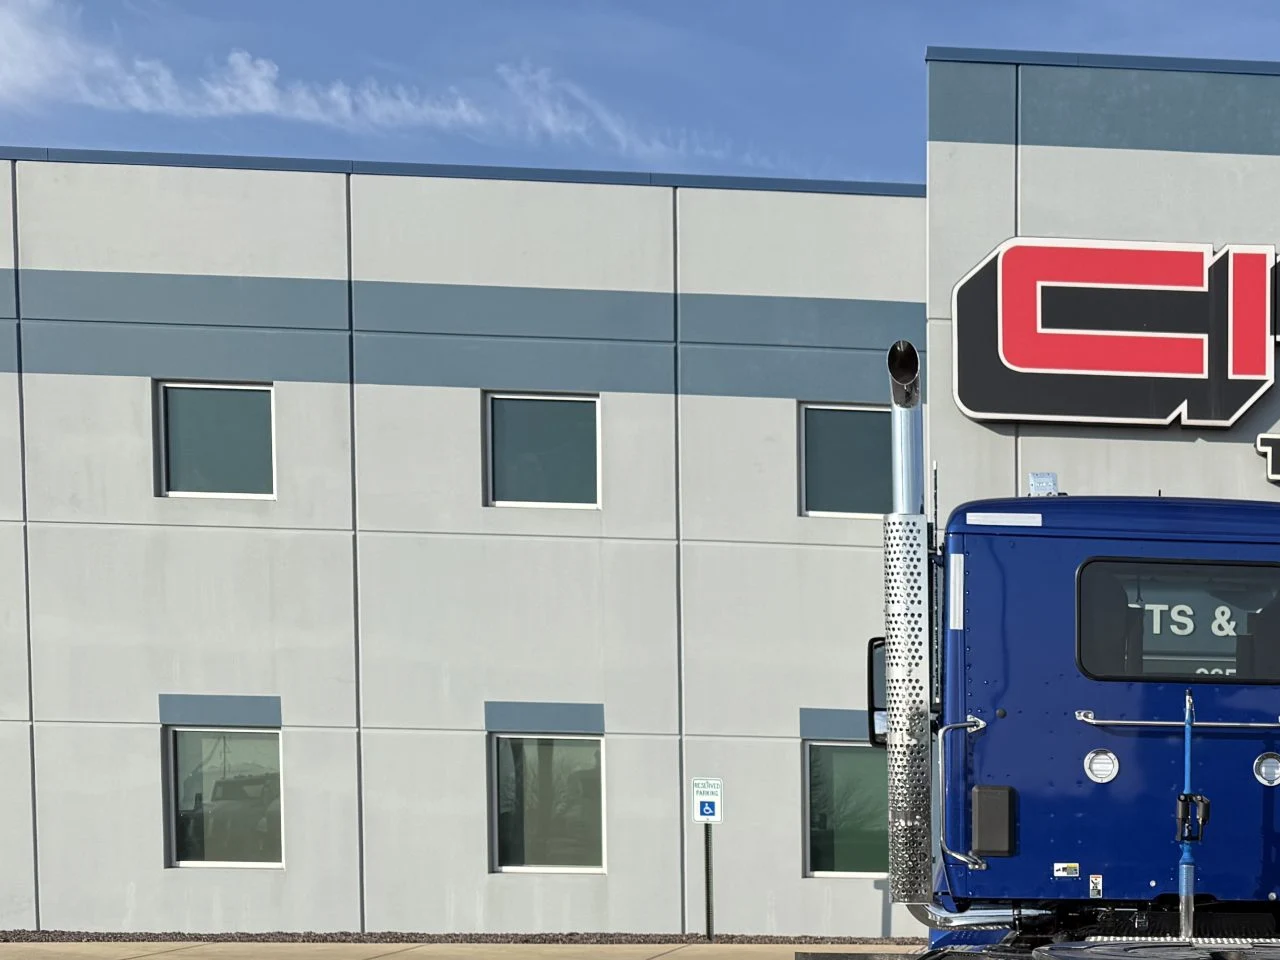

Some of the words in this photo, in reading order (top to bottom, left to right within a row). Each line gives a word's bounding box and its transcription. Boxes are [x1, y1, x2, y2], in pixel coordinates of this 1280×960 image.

[1210, 605, 1237, 637] &
[694, 782, 721, 790] RESERVED
[695, 789, 719, 797] PARKING
